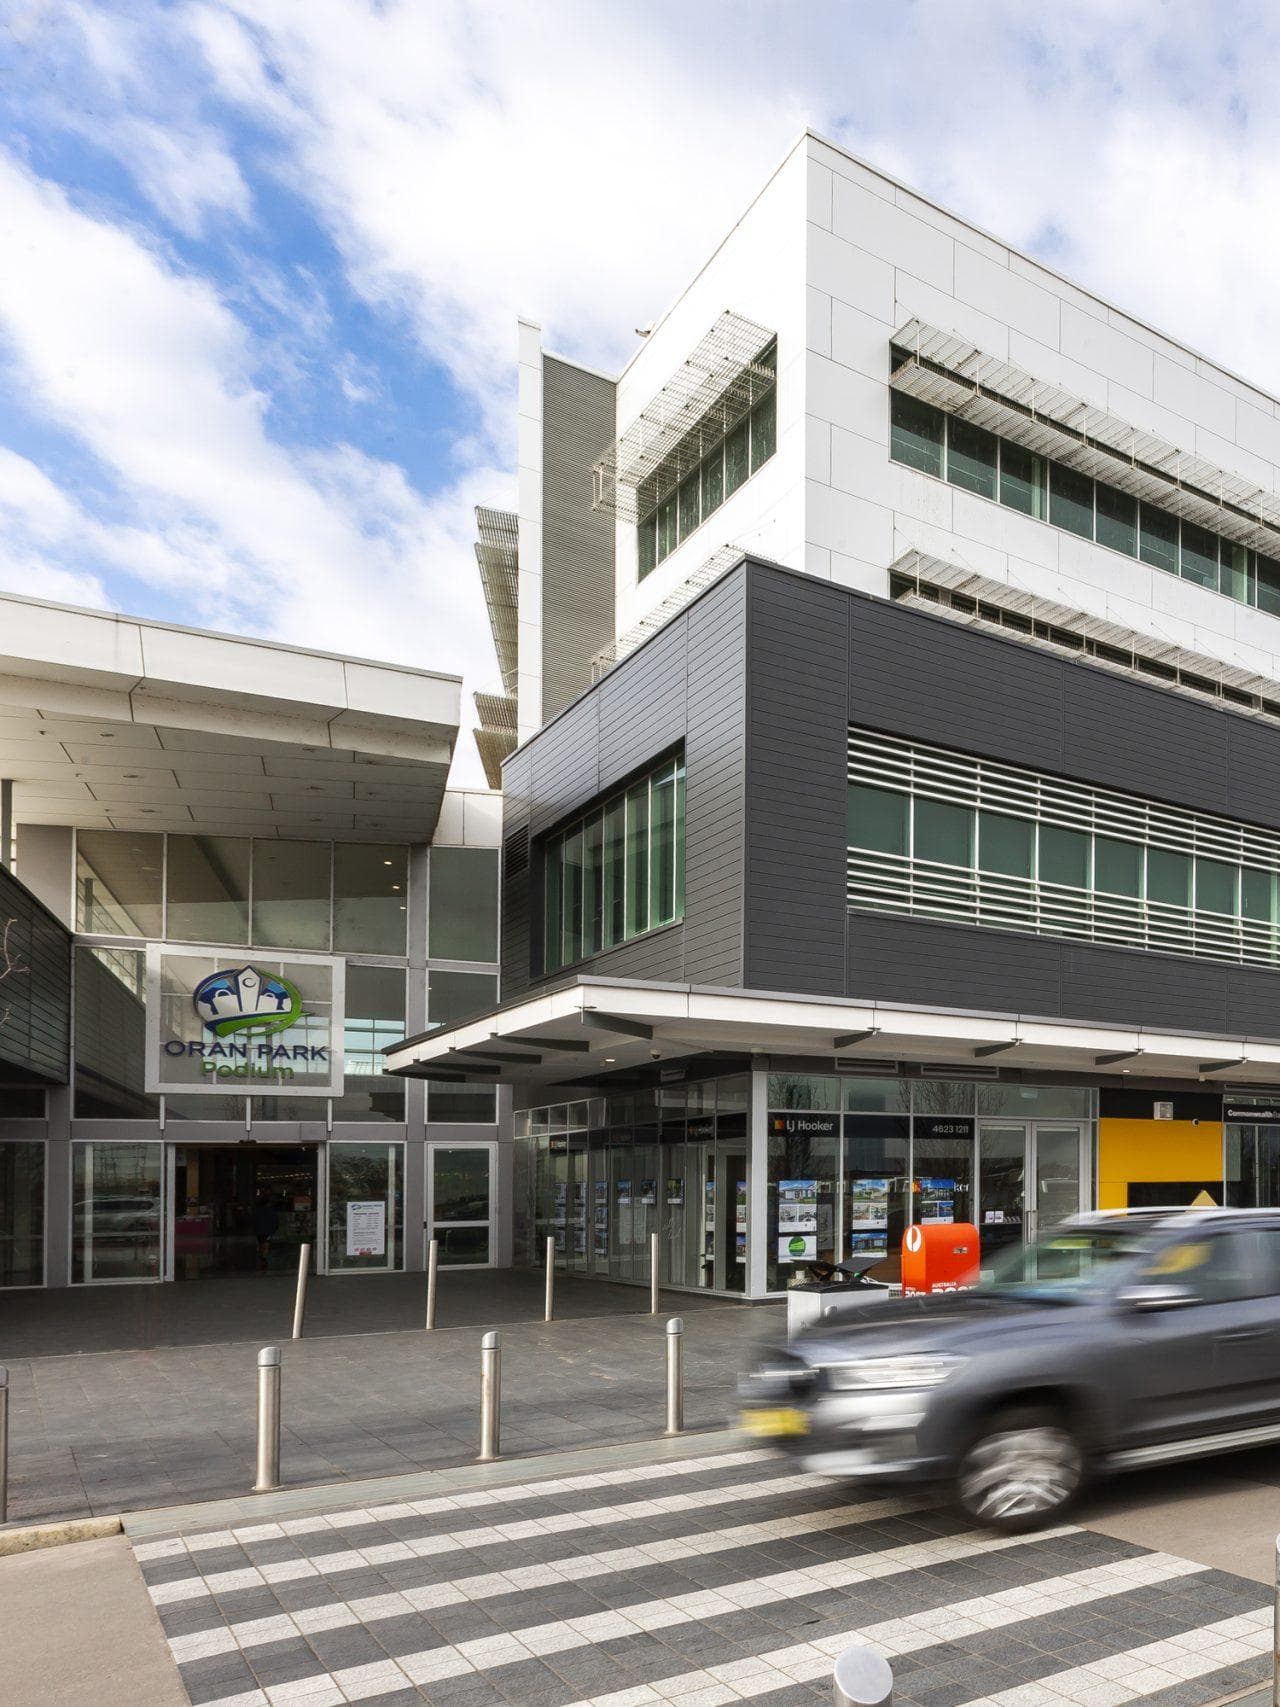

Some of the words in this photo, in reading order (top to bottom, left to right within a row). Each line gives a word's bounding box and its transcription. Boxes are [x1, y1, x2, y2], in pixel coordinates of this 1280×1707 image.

[164, 1040, 247, 1058] ORAN
[257, 1043, 329, 1061] PARK
[202, 1061, 295, 1079] Podium
[786, 1119, 795, 1133] LJ
[797, 1119, 834, 1131] Hooker
